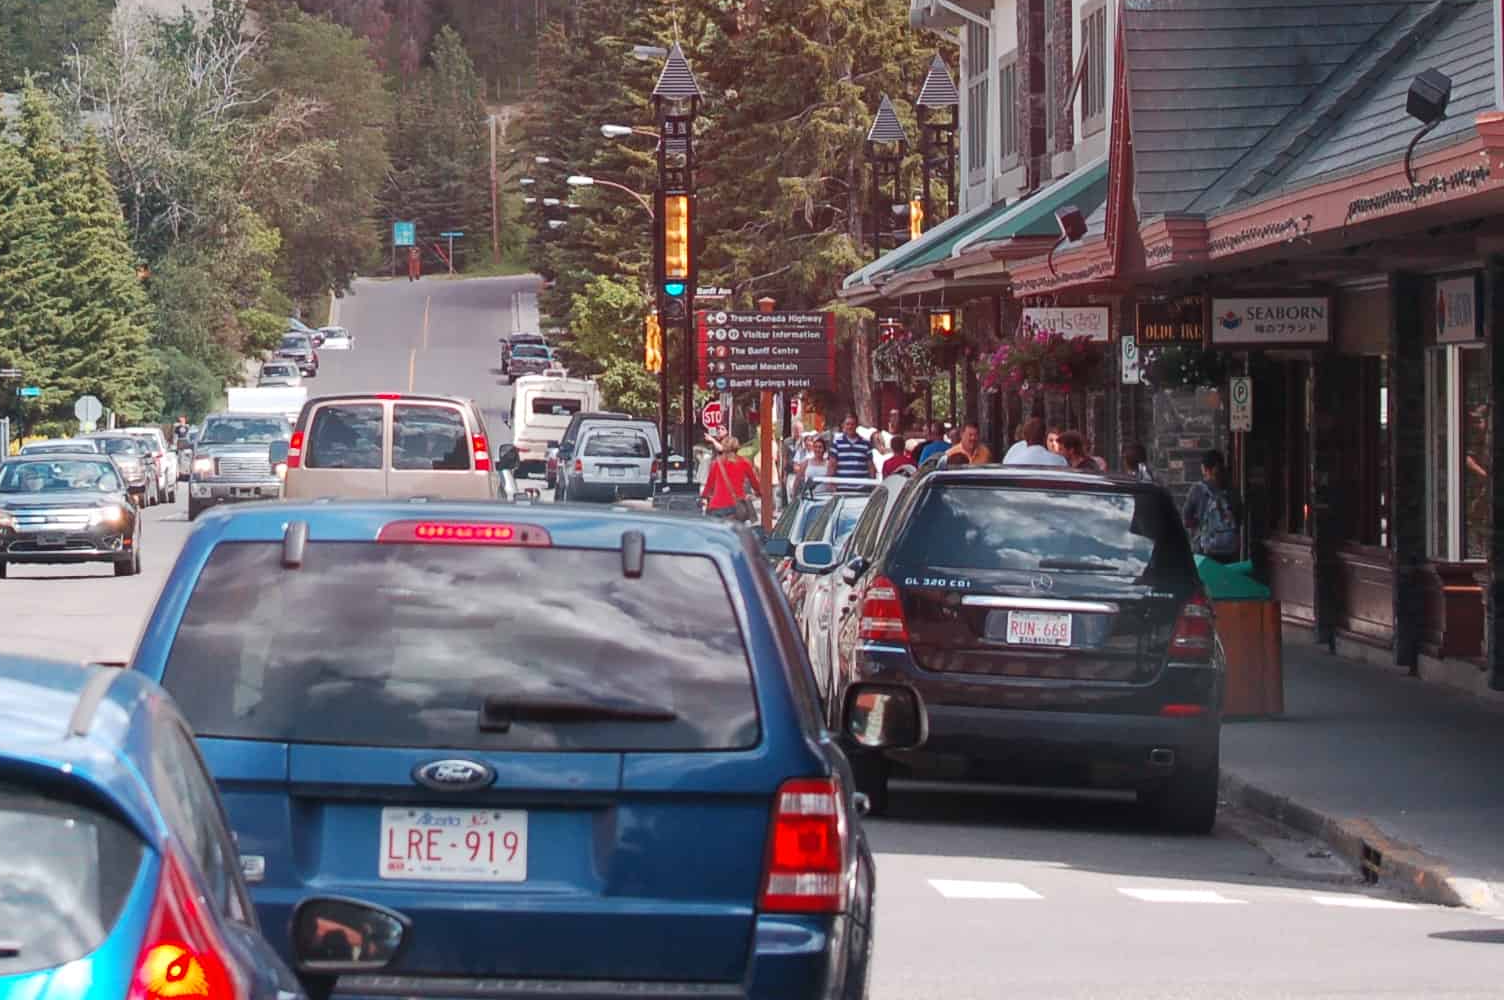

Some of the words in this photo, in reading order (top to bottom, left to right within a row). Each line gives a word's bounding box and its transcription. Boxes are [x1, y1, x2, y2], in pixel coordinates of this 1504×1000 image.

[1246, 305, 1324, 321] SEABORN
[730, 314, 786, 323] Trans-Canada
[788, 314, 823, 325] Highway
[1028, 311, 1074, 330] earls
[742, 330, 770, 339] Visitor
[772, 330, 821, 339] Information
[730, 346, 746, 355] The
[747, 346, 770, 355] Banff
[771, 346, 800, 355] Centre
[730, 362, 758, 371] Tunnel
[759, 362, 798, 372] Mountain
[729, 379, 753, 387] Banff
[754, 379, 786, 389] Springs
[787, 379, 811, 387] Hotel
[704, 410, 722, 424] STO
[904, 576, 920, 585] GL
[922, 577, 946, 586] 320
[434, 765, 473, 781] Ford
[416, 812, 461, 826] Alberta
[387, 826, 519, 863] LRE-919
